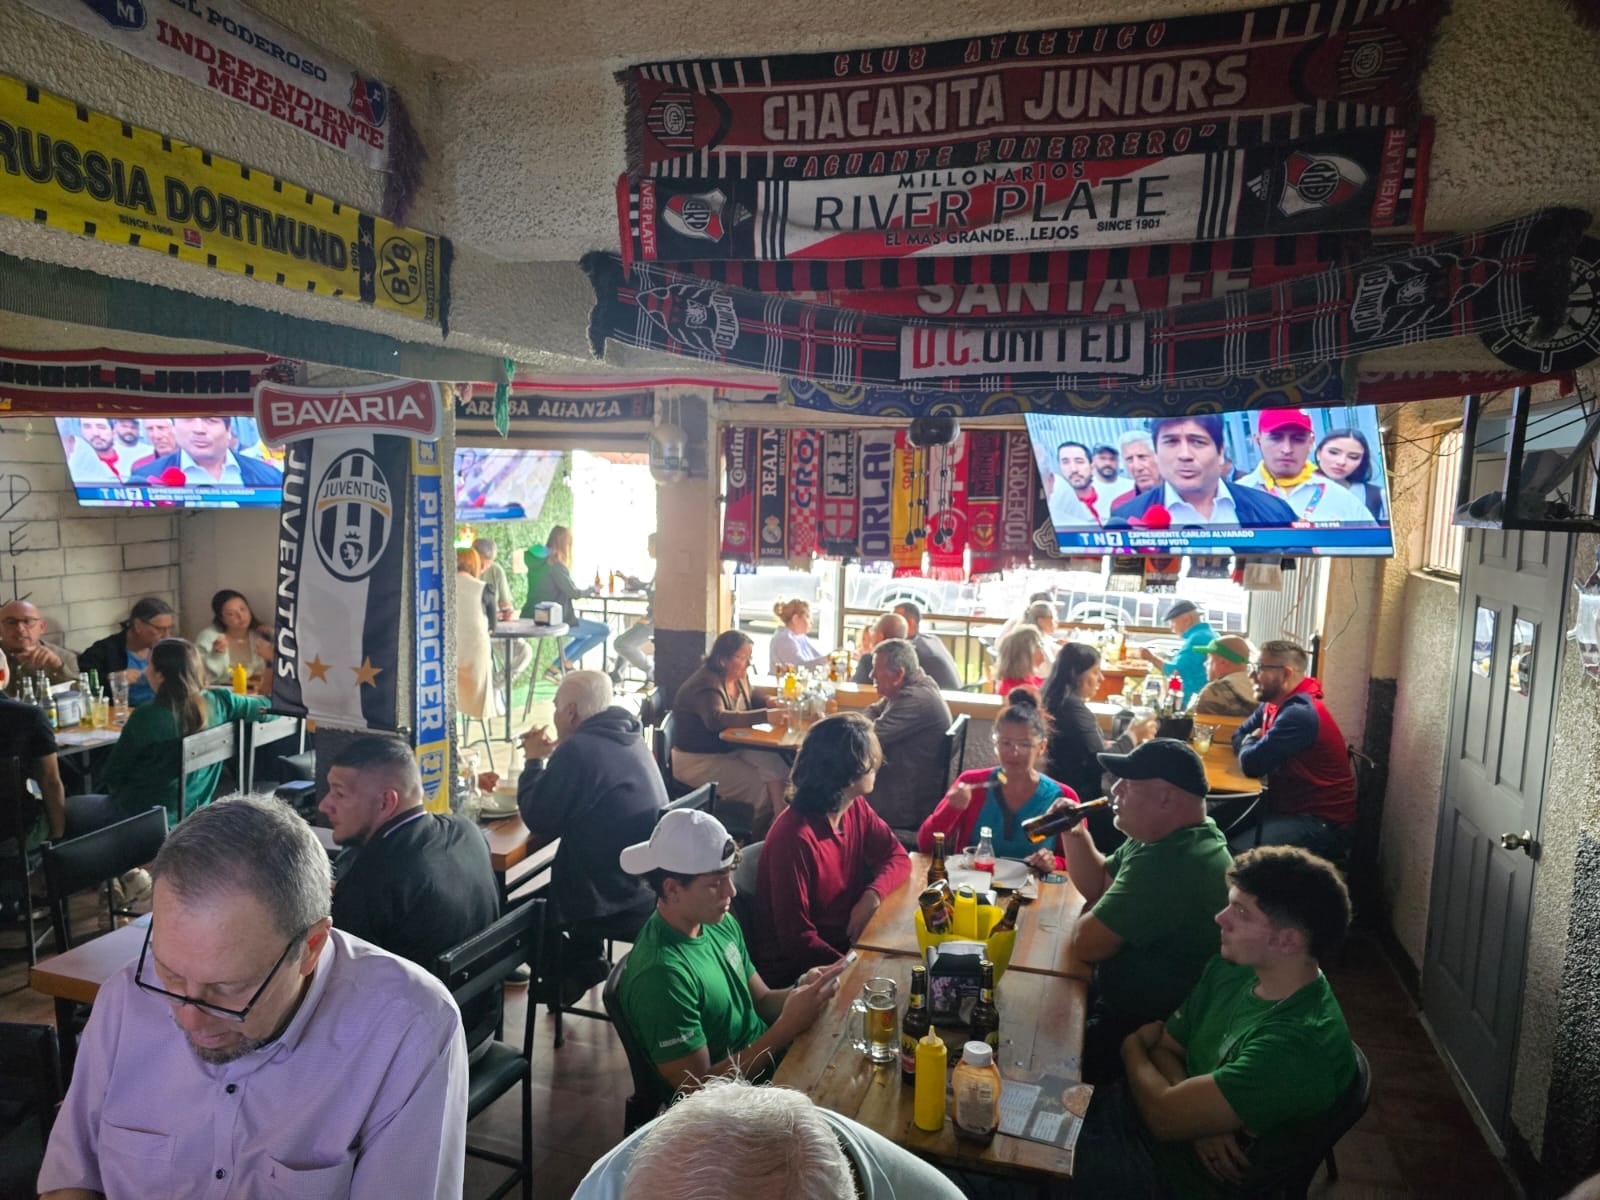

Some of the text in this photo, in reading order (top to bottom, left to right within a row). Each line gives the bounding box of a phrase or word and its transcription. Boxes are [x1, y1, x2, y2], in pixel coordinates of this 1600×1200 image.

[207, 7, 328, 82] PODEROSO
[833, 21, 1167, 76] CLUB ATLETICO
[156, 18, 385, 150] INDEPENDIENTE
[206, 65, 348, 149] MEDELLIN
[762, 55, 1249, 143] CHACARITA JUNIORS
[899, 160, 1085, 190] MILLONARIOS
[164, 175, 348, 272] DORTMUND
[814, 174, 1171, 232] RIVER PLATE
[1096, 218, 1161, 232] SINCE 1901
[641, 212, 655, 254] PLATE
[885, 231, 901, 246] EL
[906, 230, 941, 246] MAS
[382, 243, 412, 297] BVB
[269, 395, 425, 427] BAVARIA
[322, 478, 388, 504] JUVENTUS
[761, 444, 778, 497] REAL
[1212, 530, 1255, 538] ALVARADO
[276, 449, 306, 680] JUVENTUS
[419, 489, 444, 738] PITT SOCCER
